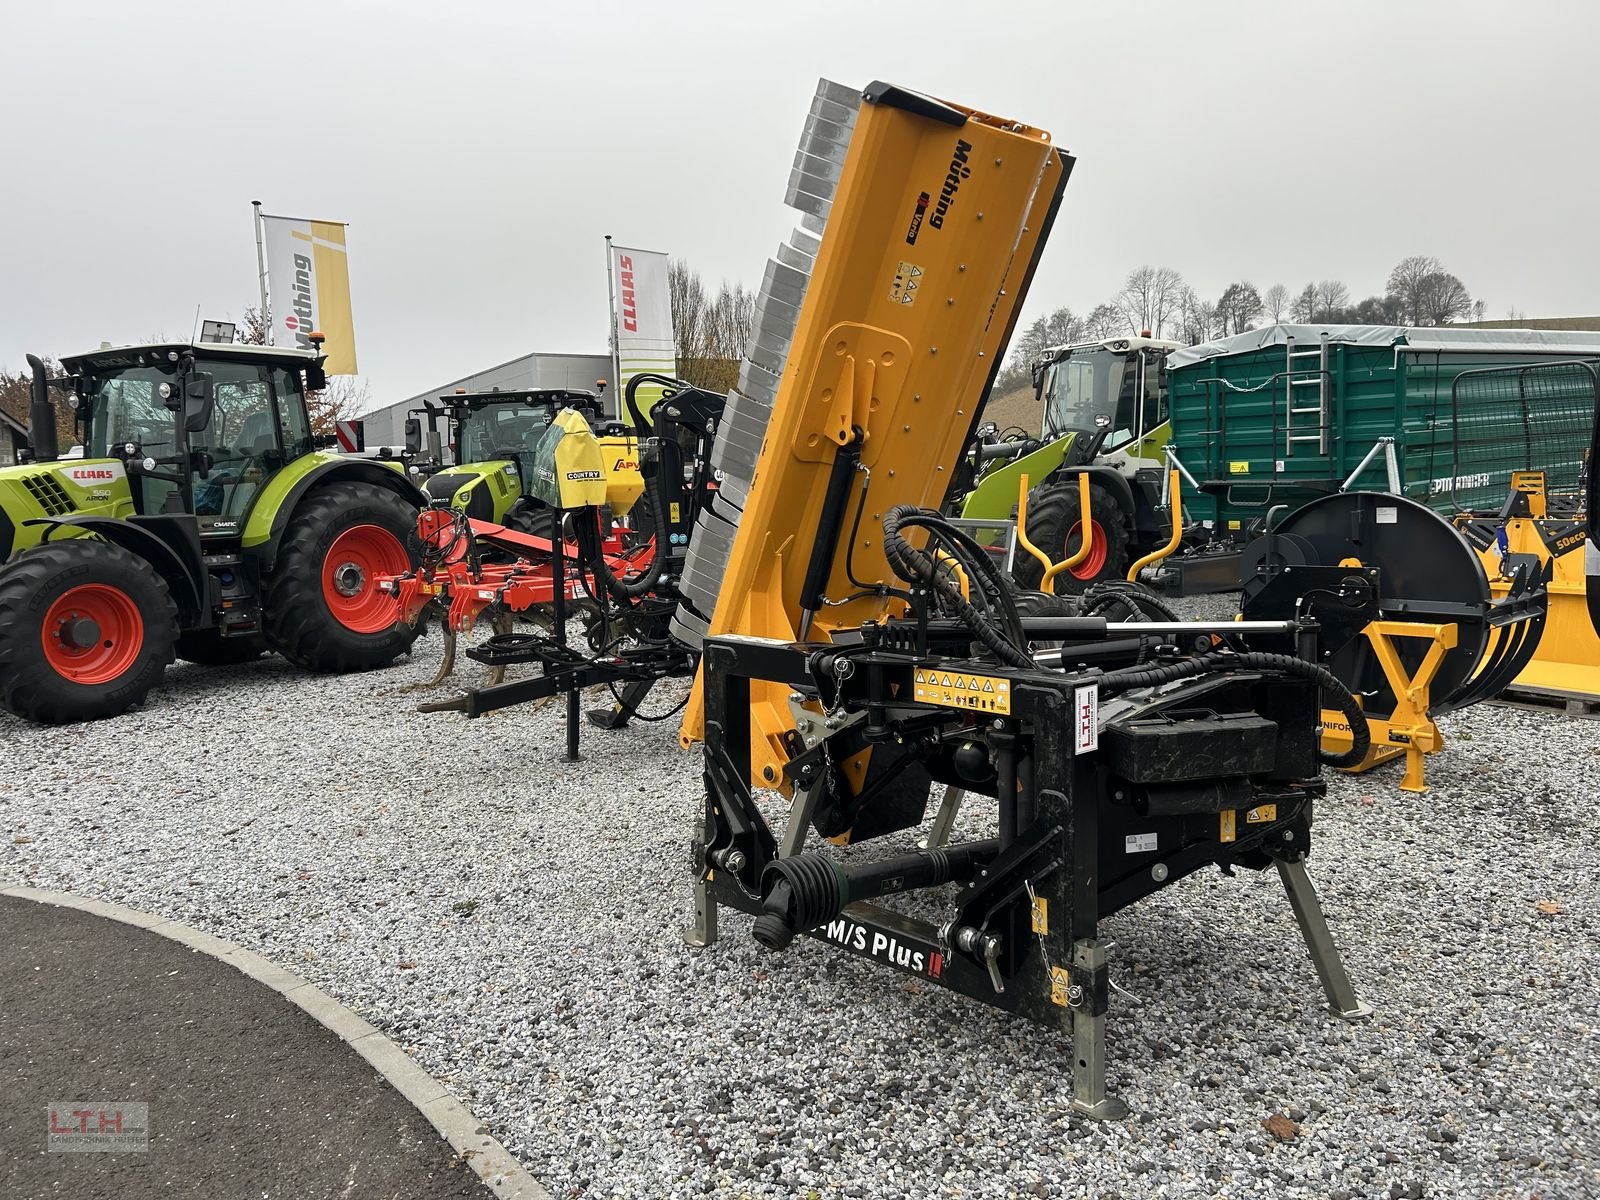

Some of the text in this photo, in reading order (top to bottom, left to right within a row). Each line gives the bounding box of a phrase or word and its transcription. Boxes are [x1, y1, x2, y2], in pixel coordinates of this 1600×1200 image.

[929, 138, 972, 230] Müthing
[908, 213, 923, 238] Vario
[620, 254, 637, 332] CLAAS
[73, 470, 113, 479] CLAAS
[567, 471, 599, 480] COUNTRY
[1556, 531, 1586, 550] 50eco
[872, 932, 924, 972] Plus
